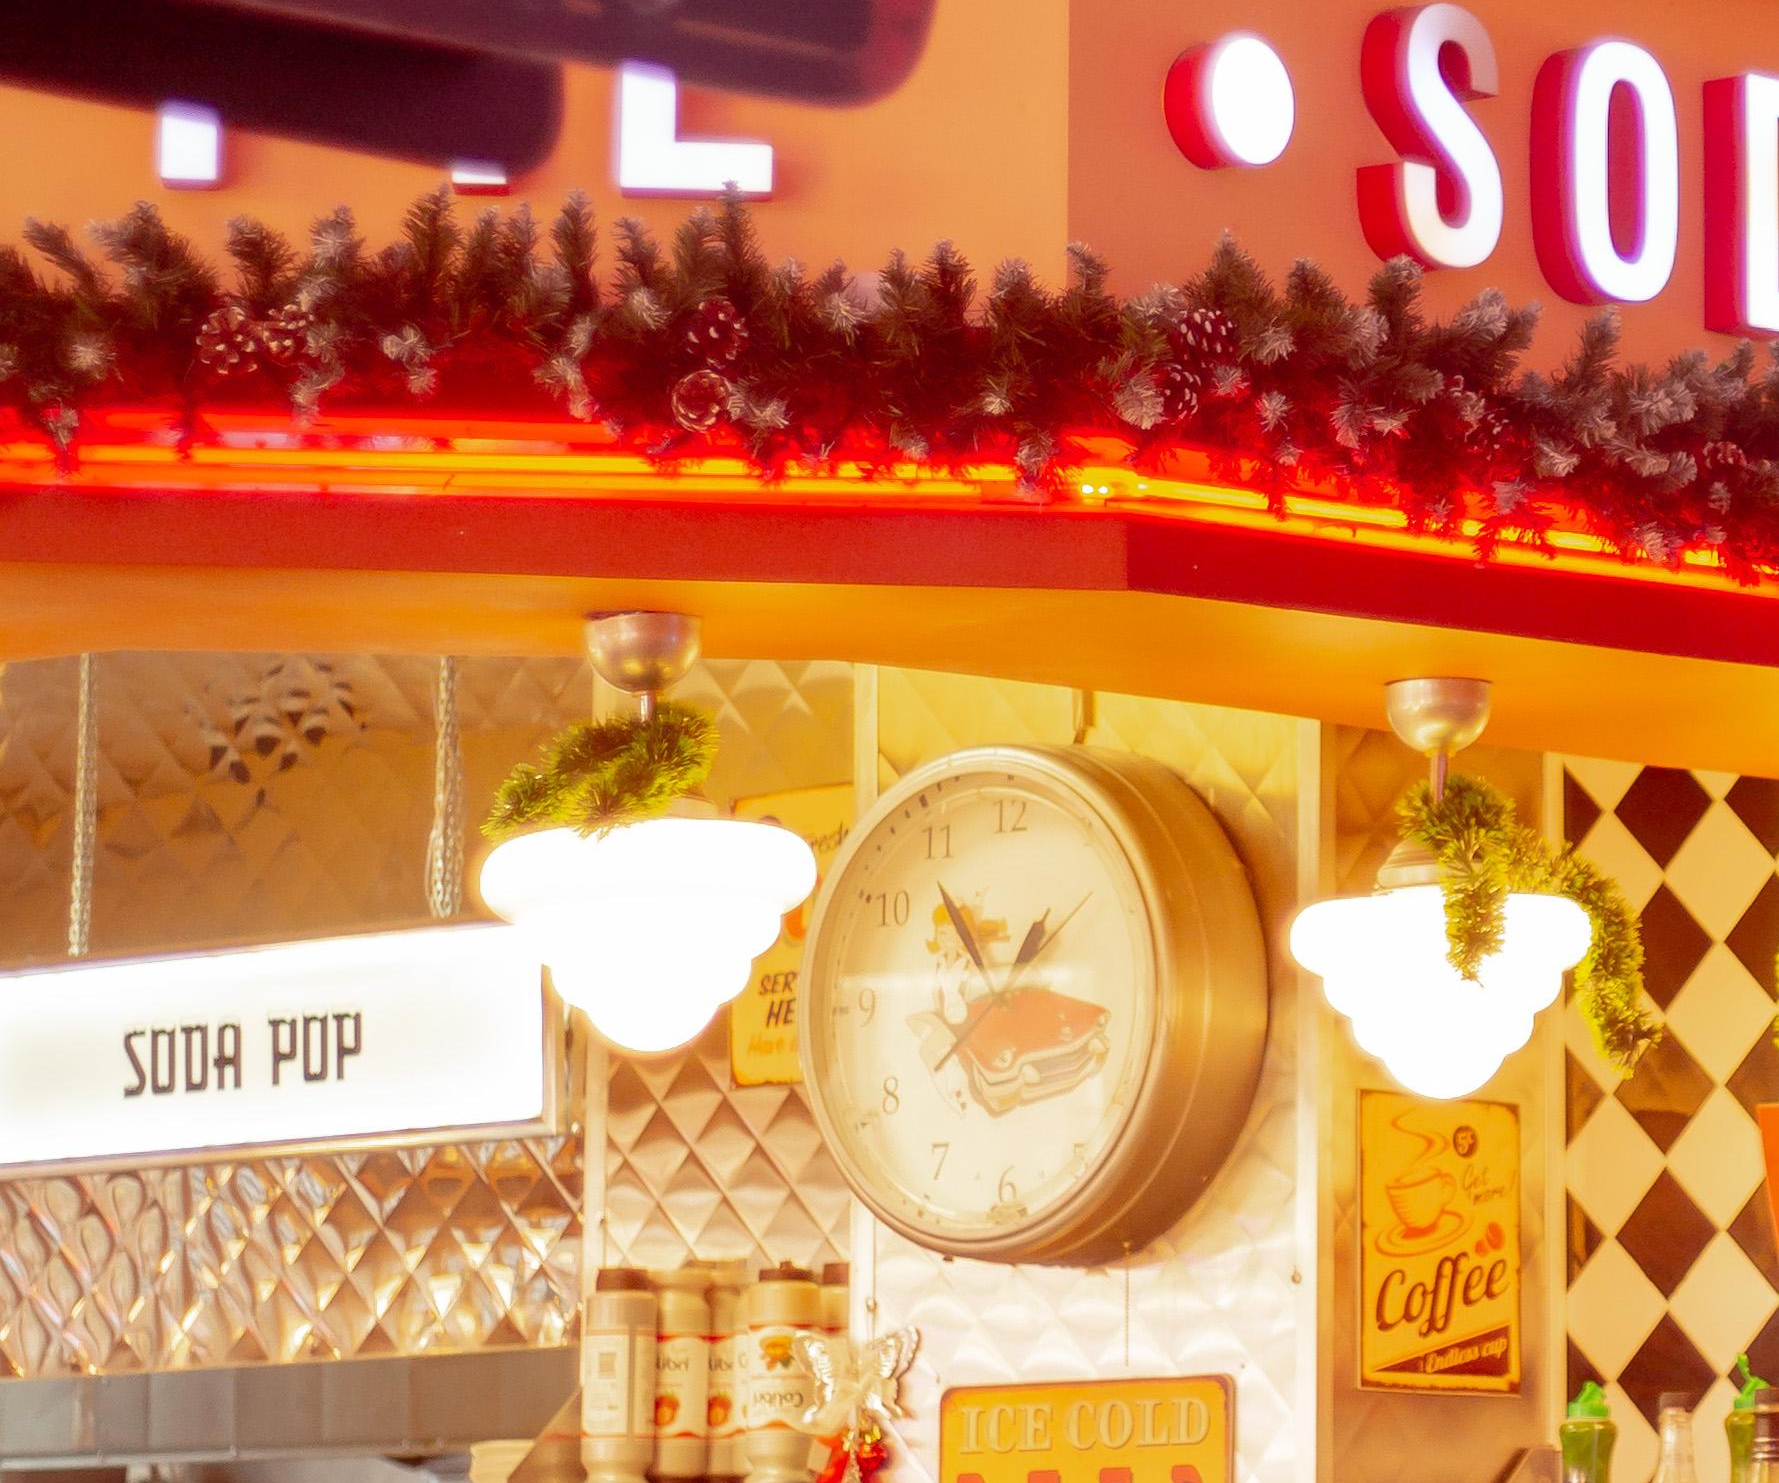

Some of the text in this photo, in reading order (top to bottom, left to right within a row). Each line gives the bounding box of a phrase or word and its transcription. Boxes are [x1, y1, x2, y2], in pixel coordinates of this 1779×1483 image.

[992, 798, 1028, 835] 12
[922, 825, 954, 860] 11
[876, 889, 910, 927] 10
[759, 971, 798, 997] SER
[766, 998, 796, 1028] HE
[858, 988, 877, 1027] 9
[123, 1011, 362, 1098] SODA POP
[882, 1076, 900, 1115] 8
[931, 1142, 951, 1180] 7
[998, 1165, 1017, 1203] 6
[1376, 1251, 1512, 1339] Coffee
[1481, 1337, 1508, 1359] cup
[960, 1397, 1210, 1455] ICE COLD
